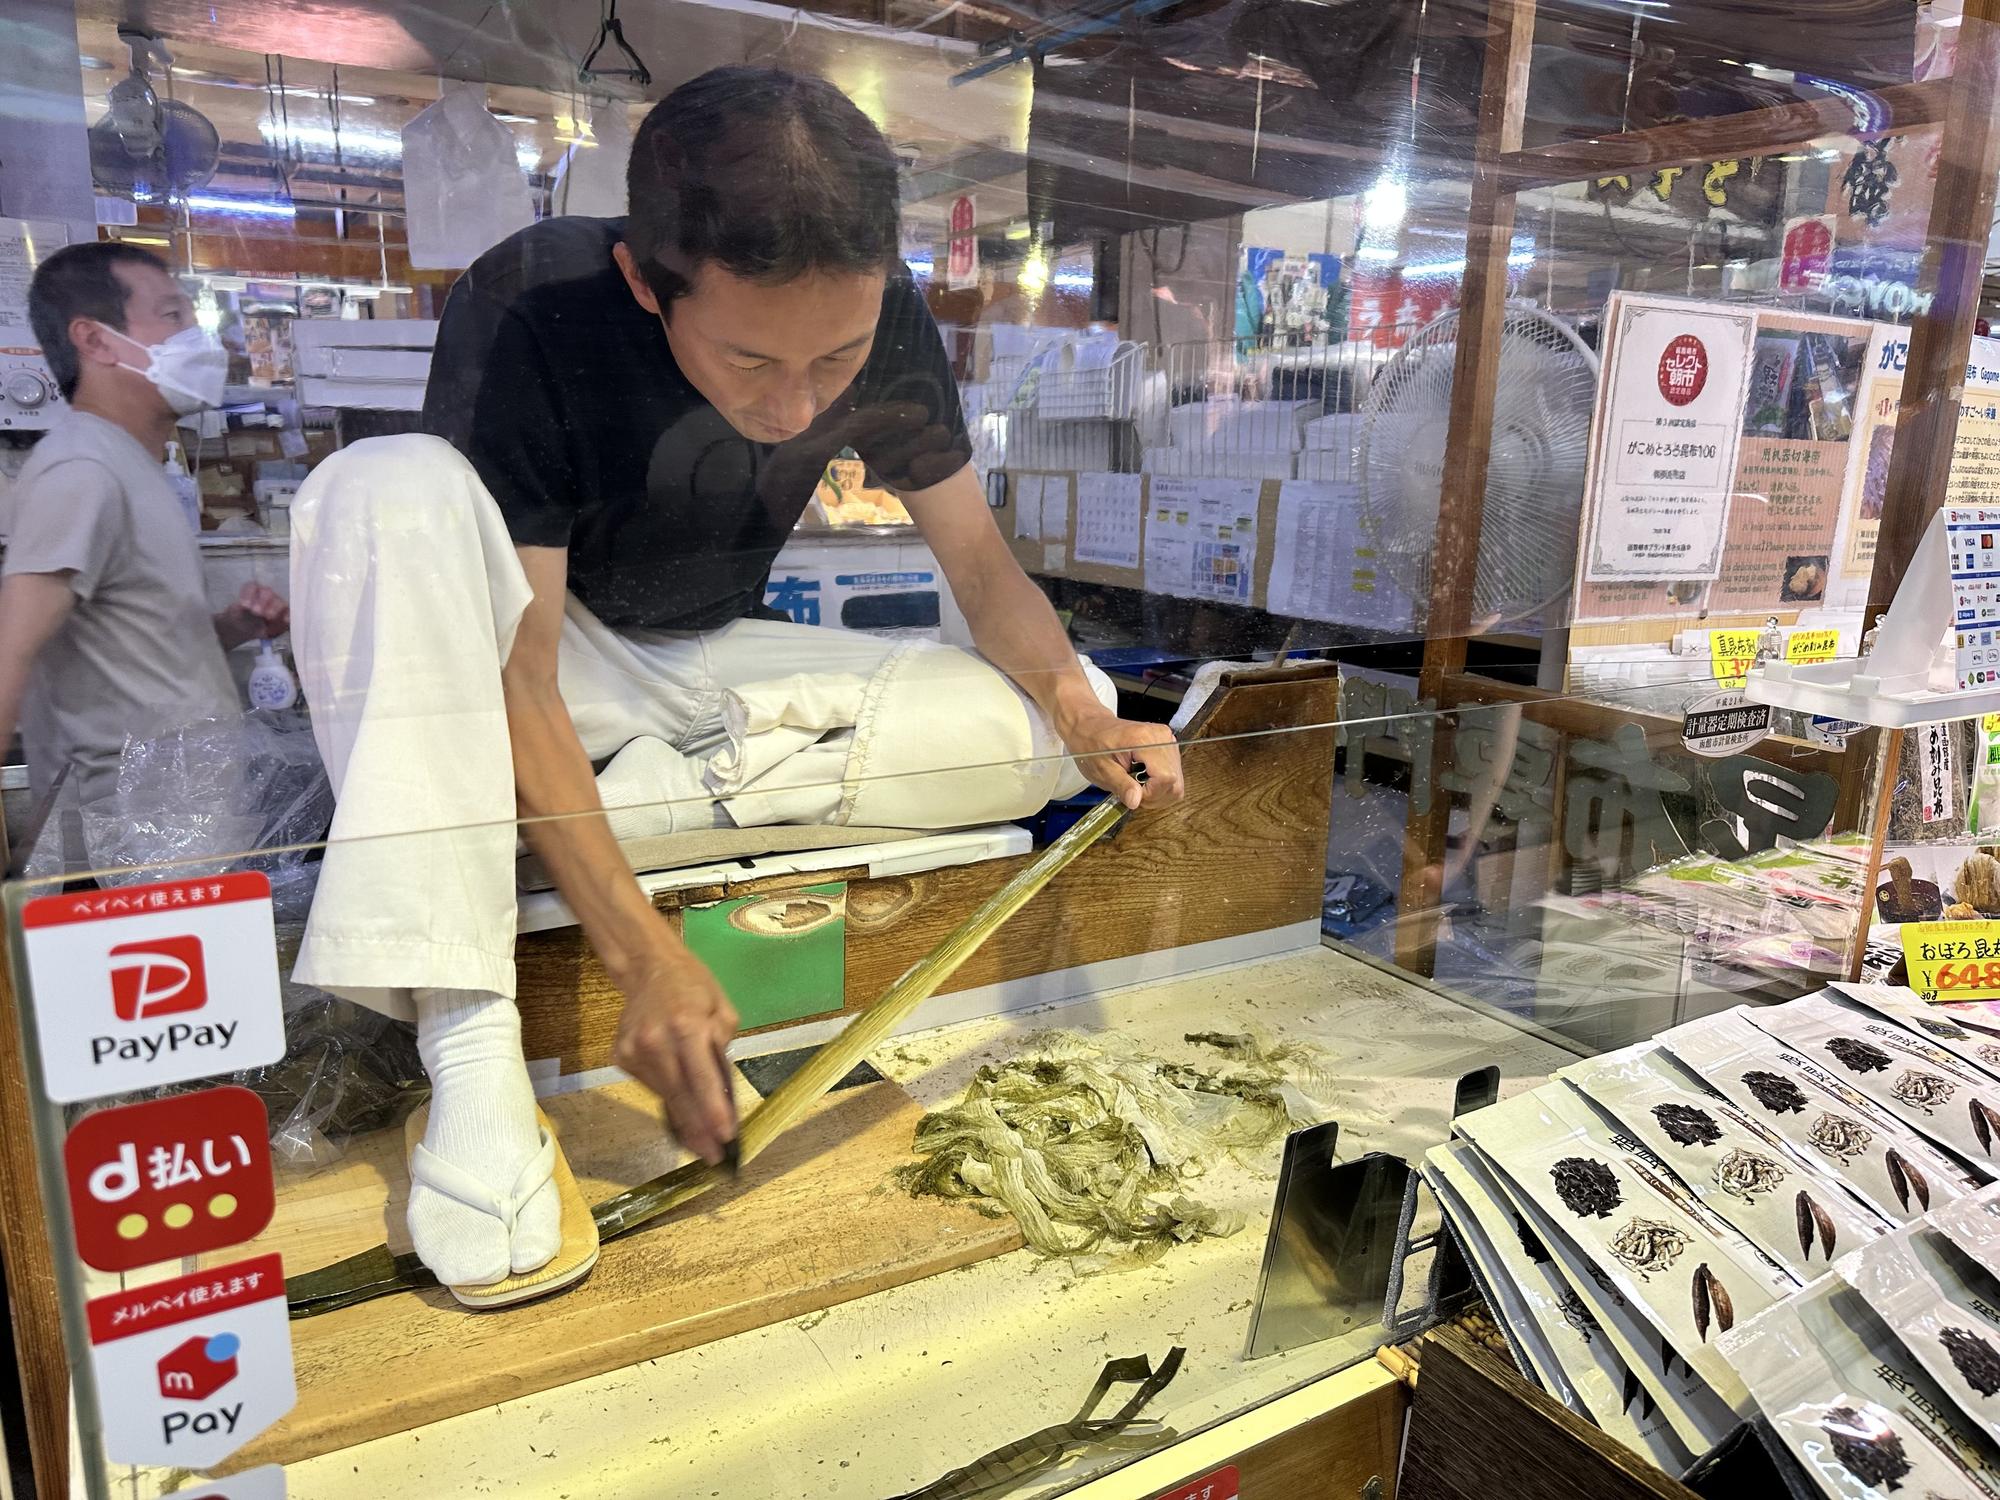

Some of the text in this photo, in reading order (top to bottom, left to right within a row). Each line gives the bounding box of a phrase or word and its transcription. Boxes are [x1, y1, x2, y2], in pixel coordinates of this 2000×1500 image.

[1666, 355, 1702, 371] セレクト
[1669, 369, 1693, 386] 朝市
[1981, 367, 2000, 384] Gagome
[1964, 538, 1976, 546] VISA
[767, 576, 821, 626] 布
[1686, 709, 1767, 736] 計量器定期検査済
[1699, 732, 1750, 749] 函館市計量検査所
[1929, 725, 1944, 818] め刻み昆布
[72, 882, 225, 917] ペイペイ使えます
[90, 1018, 240, 1066] PayPay
[87, 1134, 253, 1203] d払い
[110, 1271, 265, 1327] メルペイ使えます
[160, 1401, 245, 1445] Pay
